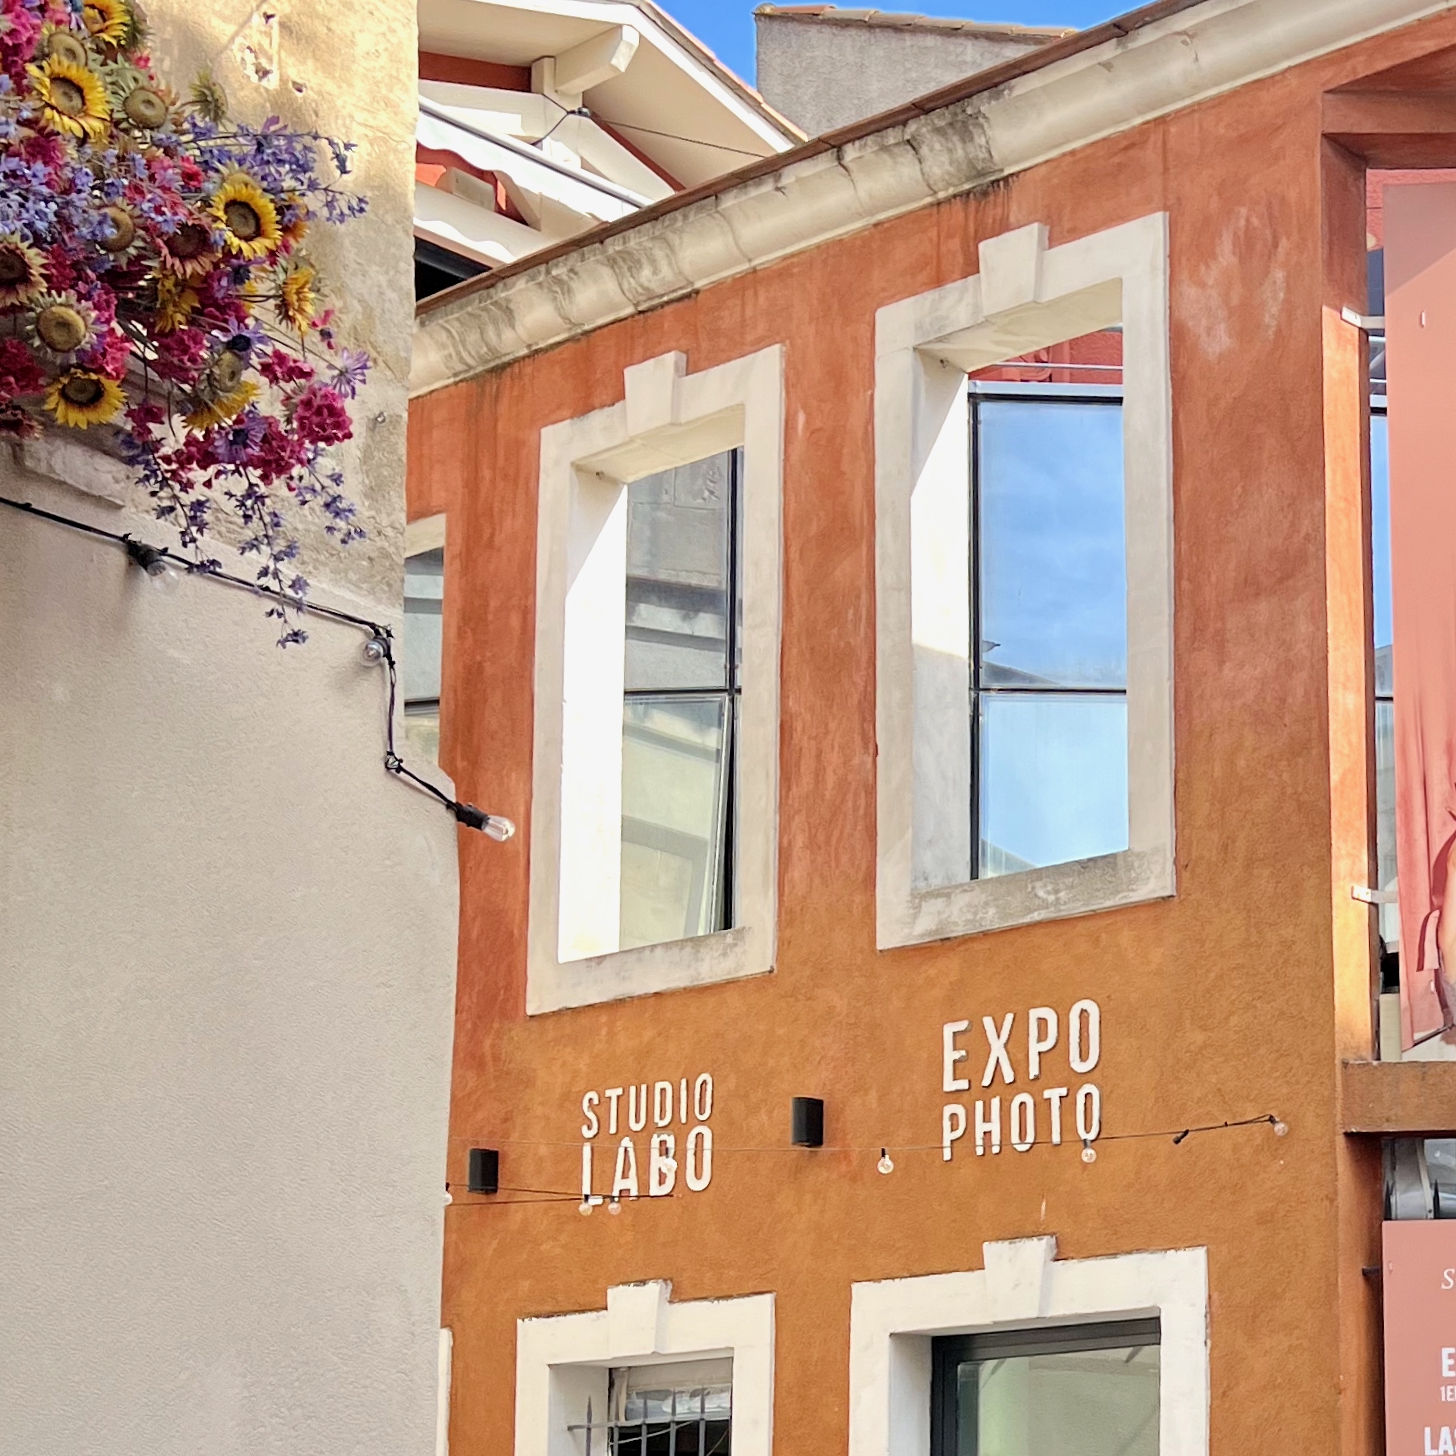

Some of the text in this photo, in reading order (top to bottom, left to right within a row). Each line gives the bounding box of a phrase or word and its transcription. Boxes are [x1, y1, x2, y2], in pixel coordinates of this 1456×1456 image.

[942, 998, 1102, 1092] EXPO
[581, 1072, 714, 1138] STUDIO
[942, 1083, 1102, 1161] PHOTO
[581, 1126, 713, 1205] LABO
